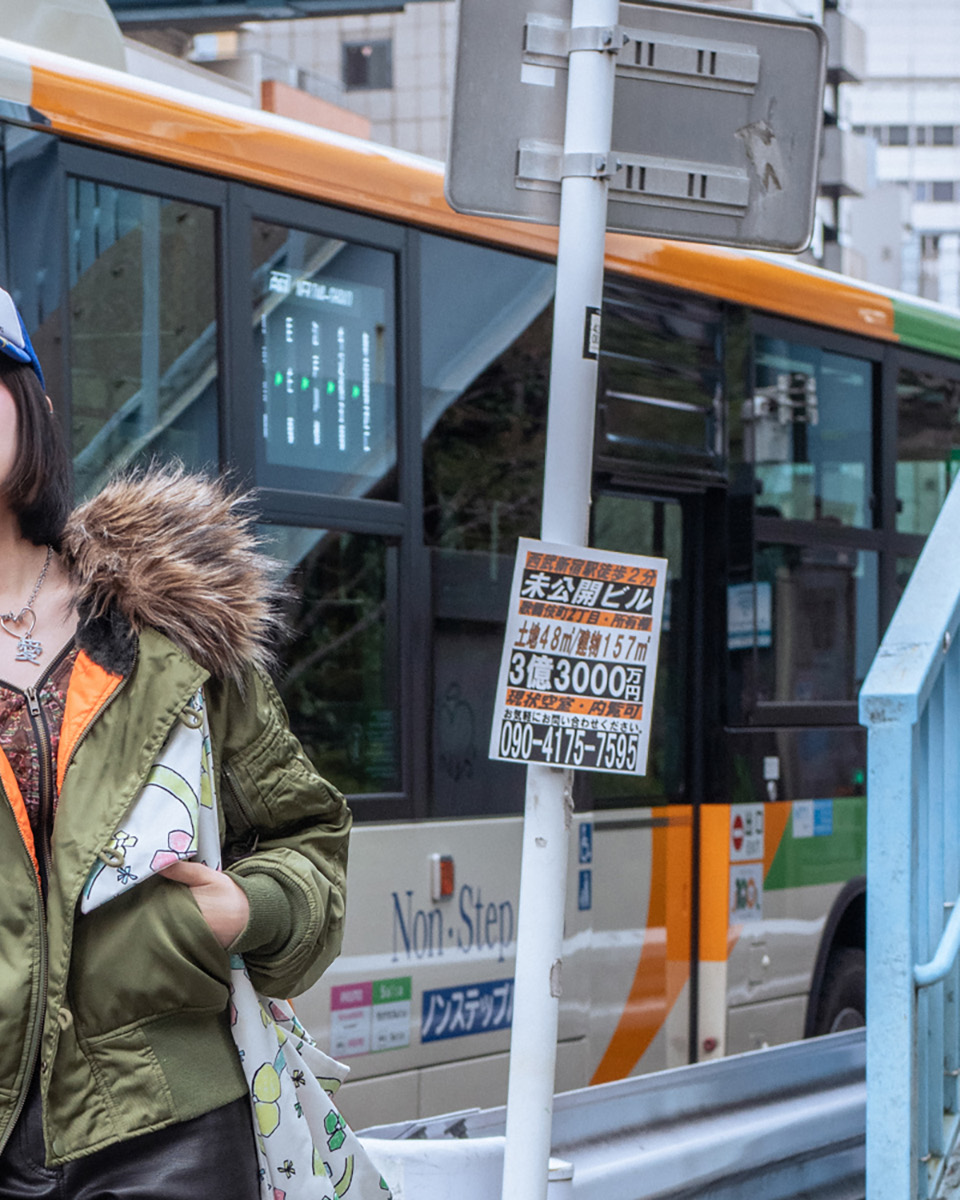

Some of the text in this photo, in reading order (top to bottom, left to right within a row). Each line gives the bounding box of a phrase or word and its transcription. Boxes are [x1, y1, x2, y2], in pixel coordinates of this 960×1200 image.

[521, 571, 653, 612] 未公開ビル
[509, 651, 644, 701] 3億3000万円
[500, 721, 639, 770] 090-4175-7595
[421, 982, 514, 1036] ノンステップ
